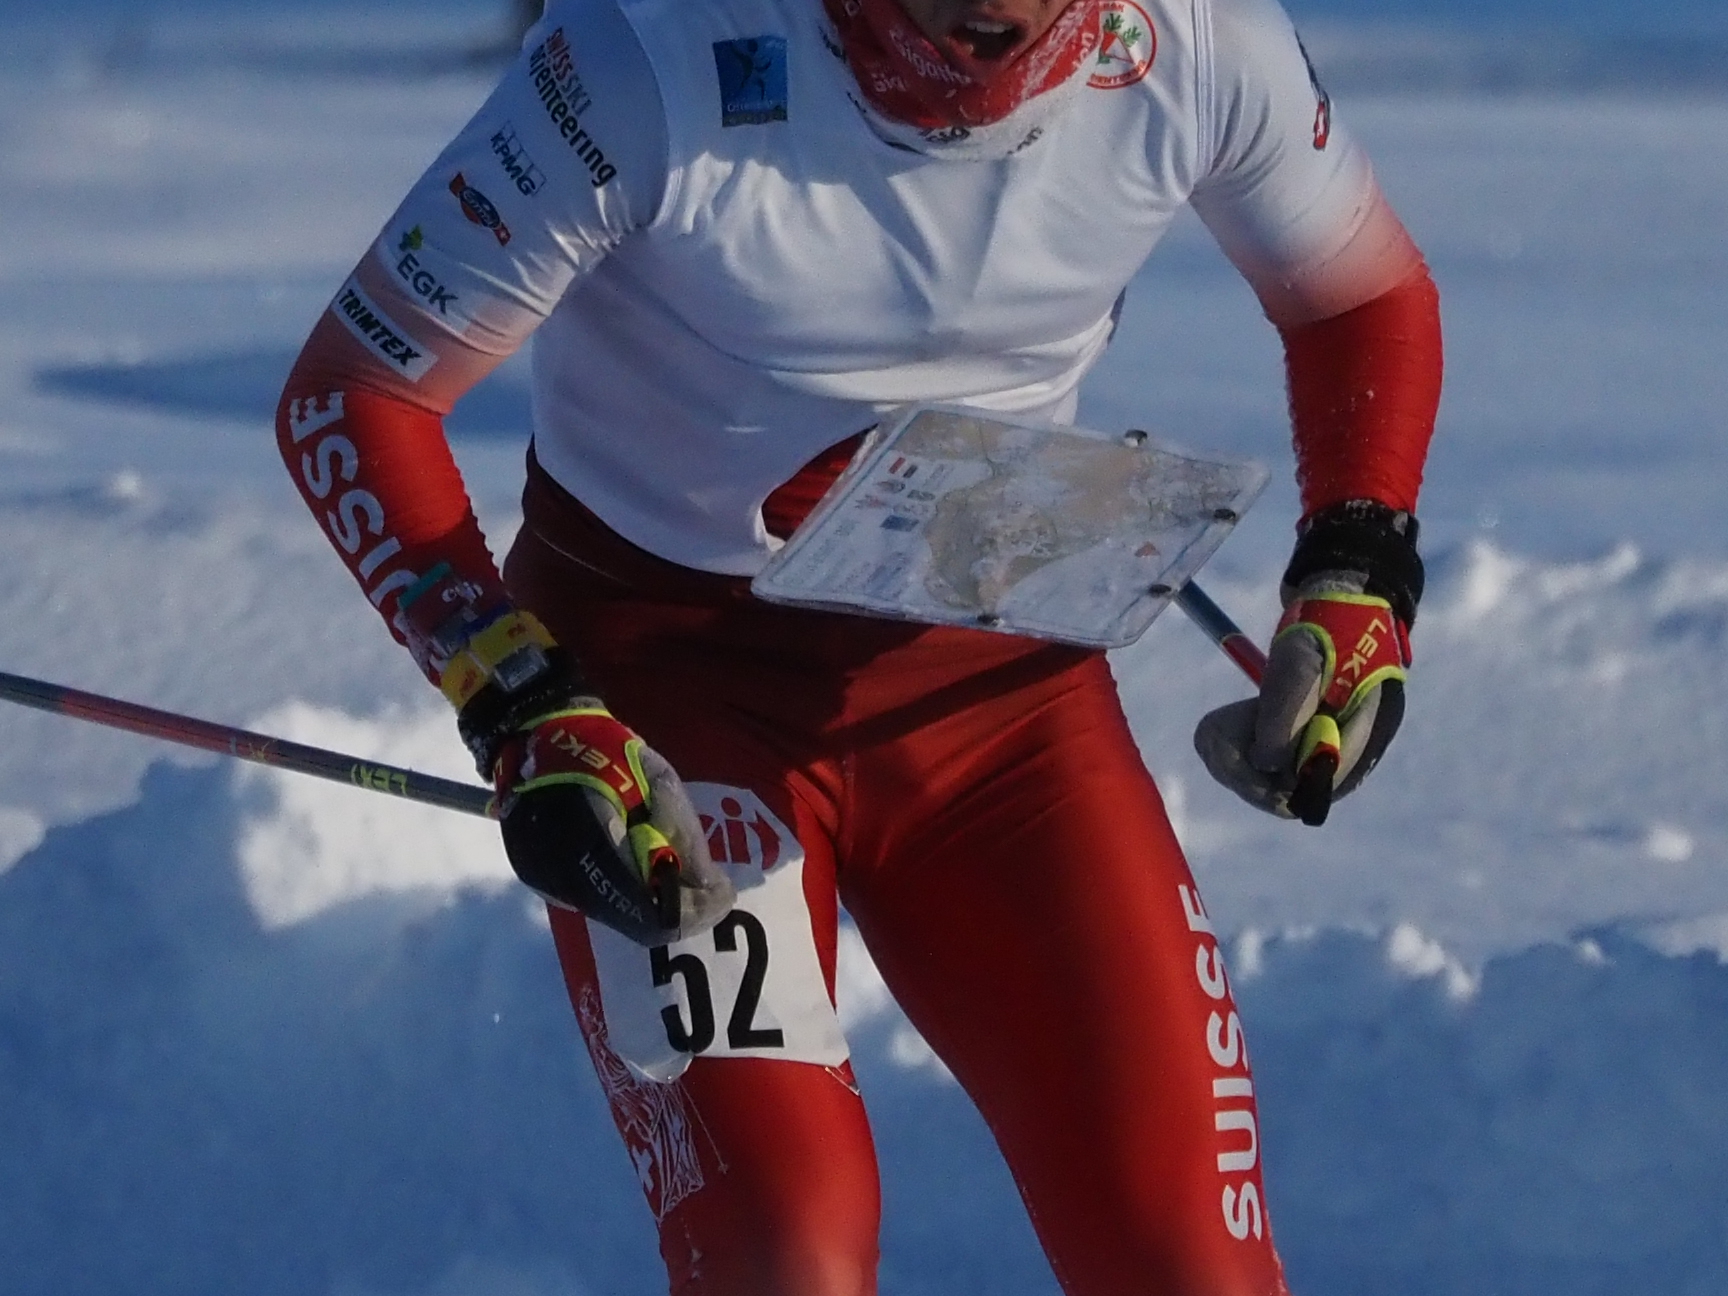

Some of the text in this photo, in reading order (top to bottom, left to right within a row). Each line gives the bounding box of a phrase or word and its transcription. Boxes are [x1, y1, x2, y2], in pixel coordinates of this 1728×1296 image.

[529, 43, 618, 188] orienteering
[489, 131, 537, 197] KPMG
[396, 253, 459, 315] EGK
[338, 288, 422, 367] TRIMTEX
[1335, 617, 1388, 689] LEKI
[550, 728, 635, 794] LEKI
[578, 850, 645, 924] HESTRA
[649, 909, 785, 1055] 52
